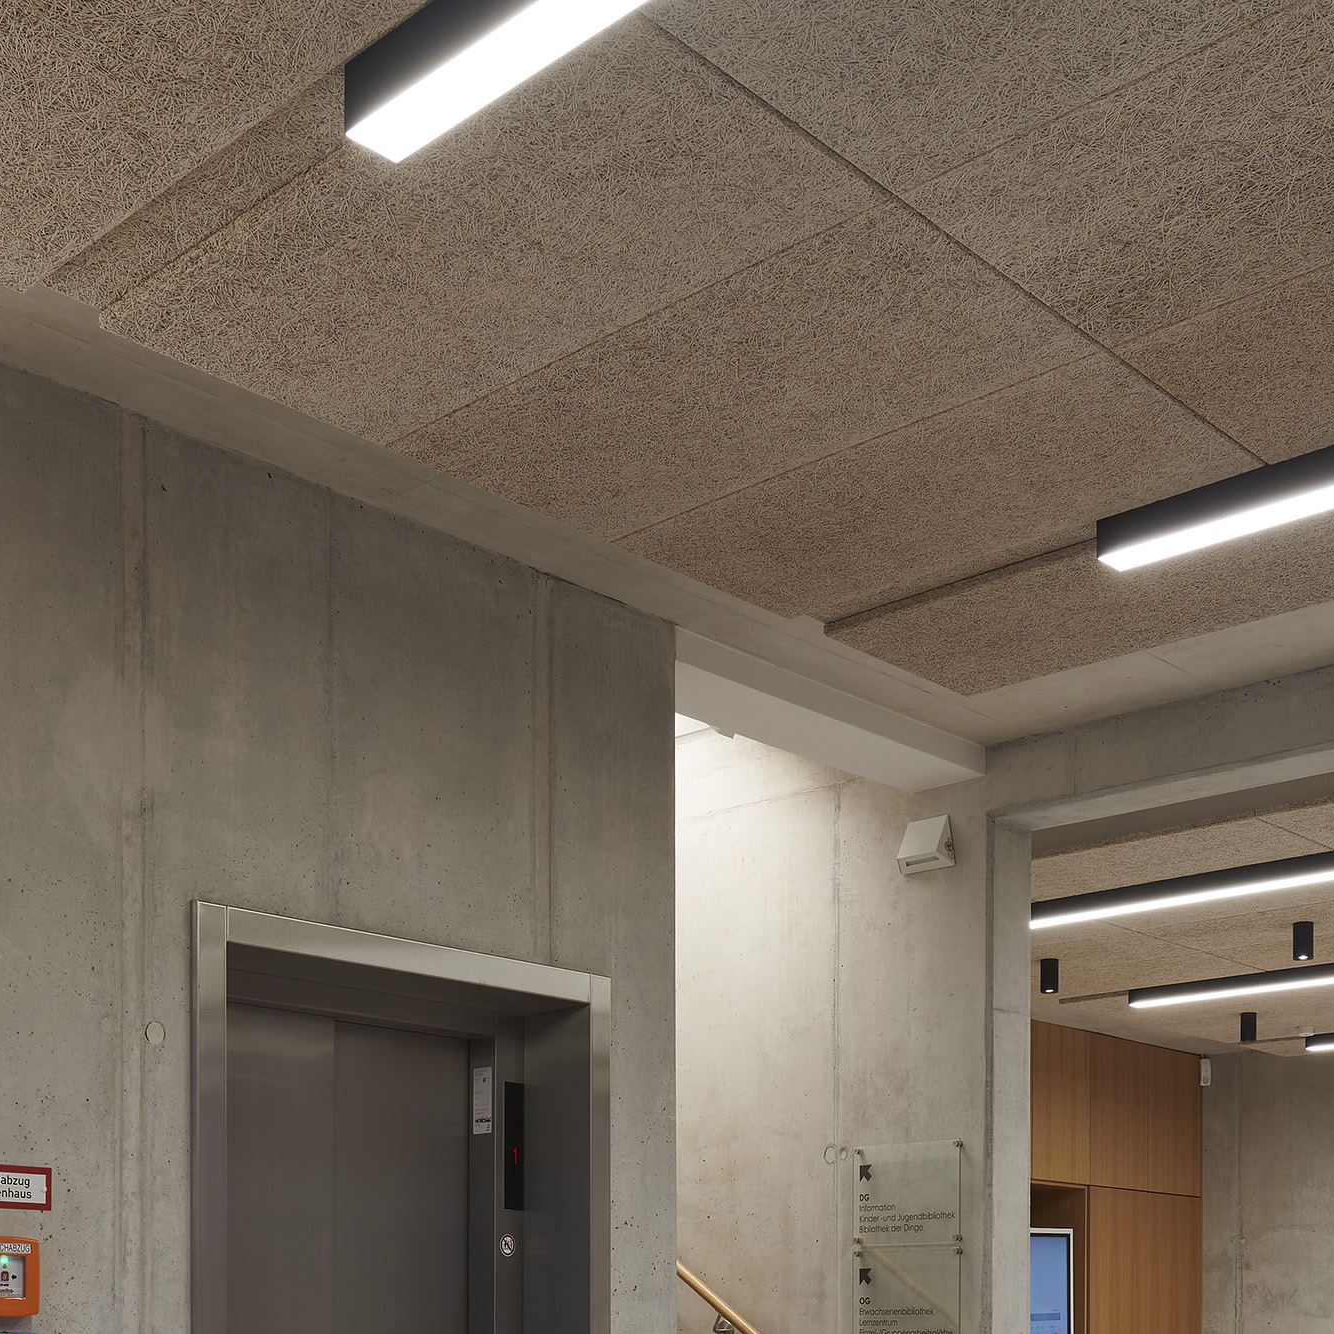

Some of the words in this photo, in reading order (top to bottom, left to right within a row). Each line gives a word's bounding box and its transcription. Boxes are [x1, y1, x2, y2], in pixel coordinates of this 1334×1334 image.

[859, 1204, 896, 1212] Information
[859, 1214, 879, 1222] Kinder
[897, 1211, 956, 1222] Jugendbibliothek
[859, 1225, 889, 1233] Bibliothek
[904, 1224, 924, 1233] Dinge
[859, 1308, 934, 1316] Erwachsenenbibliothek
